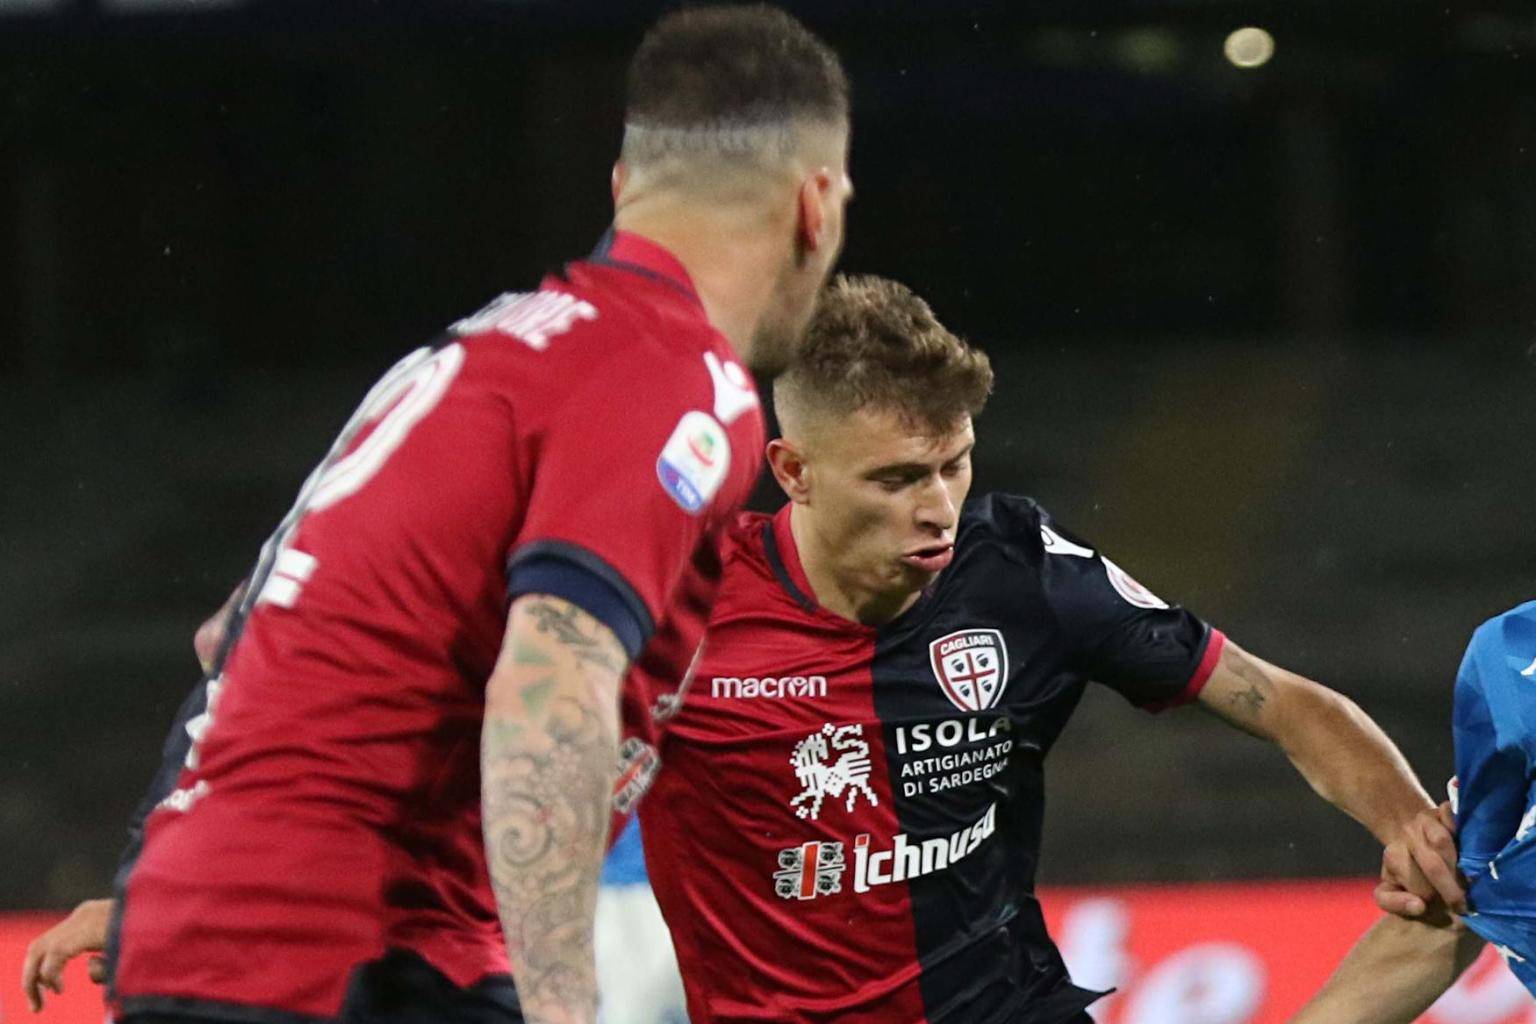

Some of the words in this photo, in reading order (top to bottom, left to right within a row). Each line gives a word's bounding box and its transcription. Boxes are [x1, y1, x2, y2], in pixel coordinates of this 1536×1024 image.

[940, 635, 995, 655] CAGLIARI
[711, 675, 827, 699] macron
[896, 715, 1011, 755] ISOLA
[900, 739, 1013, 778] ARTIGIANATO
[903, 781, 923, 798] DI
[929, 757, 1009, 793] SARDEGNA
